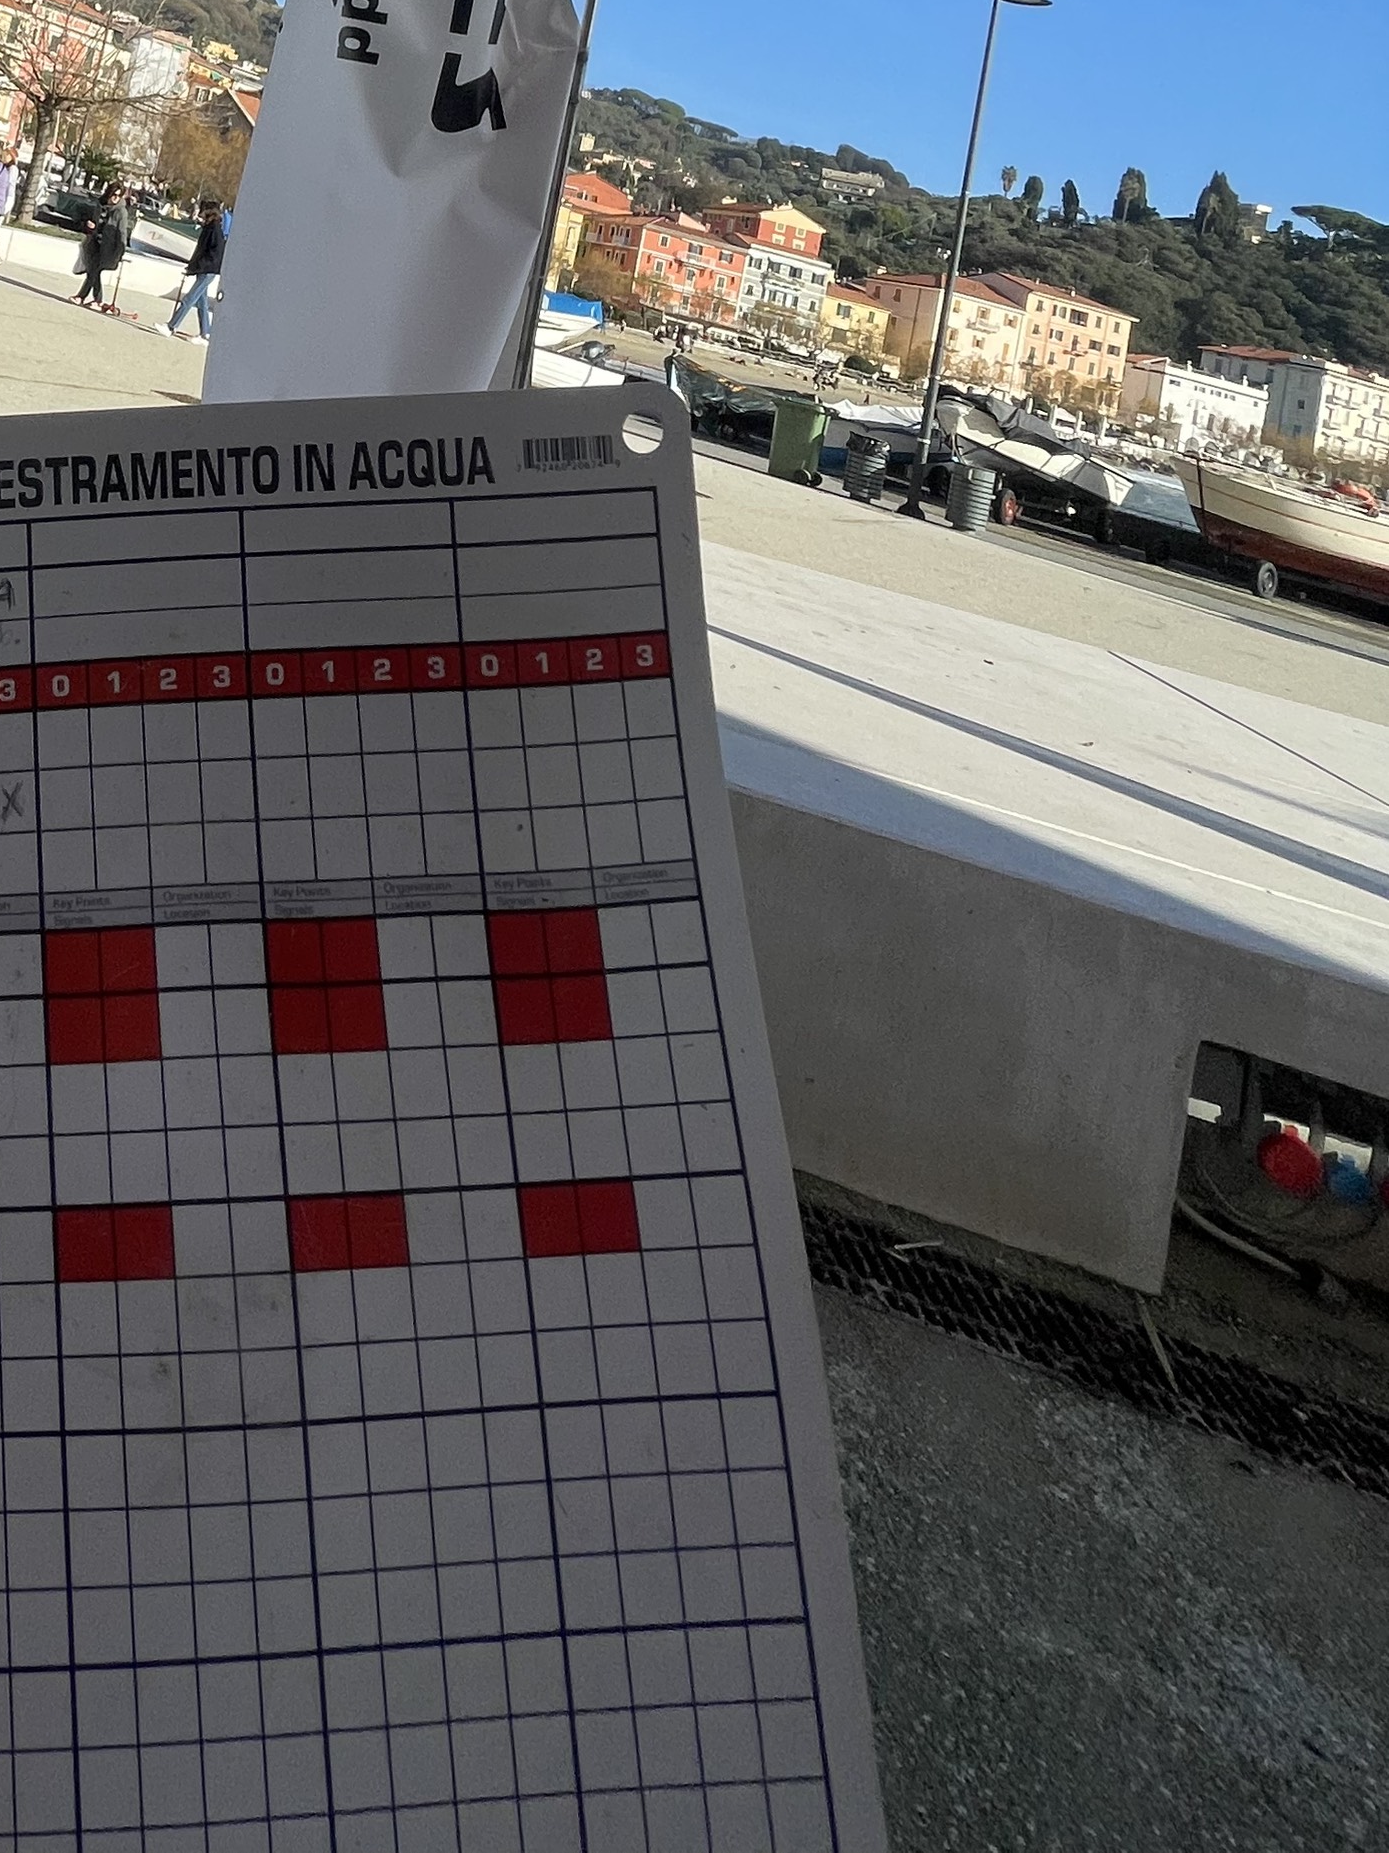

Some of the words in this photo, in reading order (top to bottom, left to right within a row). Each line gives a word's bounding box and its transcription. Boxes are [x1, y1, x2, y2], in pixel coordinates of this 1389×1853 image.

[293, 441, 341, 493] IN
[348, 436, 496, 491] ACQUA
[266, 663, 284, 686] 0
[321, 661, 334, 683] 1
[374, 659, 392, 680] 2
[428, 656, 445, 678] 3
[481, 654, 498, 676] 0
[535, 652, 548, 673] 1
[586, 649, 603, 670] 2
[636, 645, 653, 667] 3
[0, 679, 16, 702] 3
[53, 675, 69, 697] 0
[107, 672, 121, 694] 1
[159, 668, 178, 690] 2
[212, 665, 230, 687] 3
